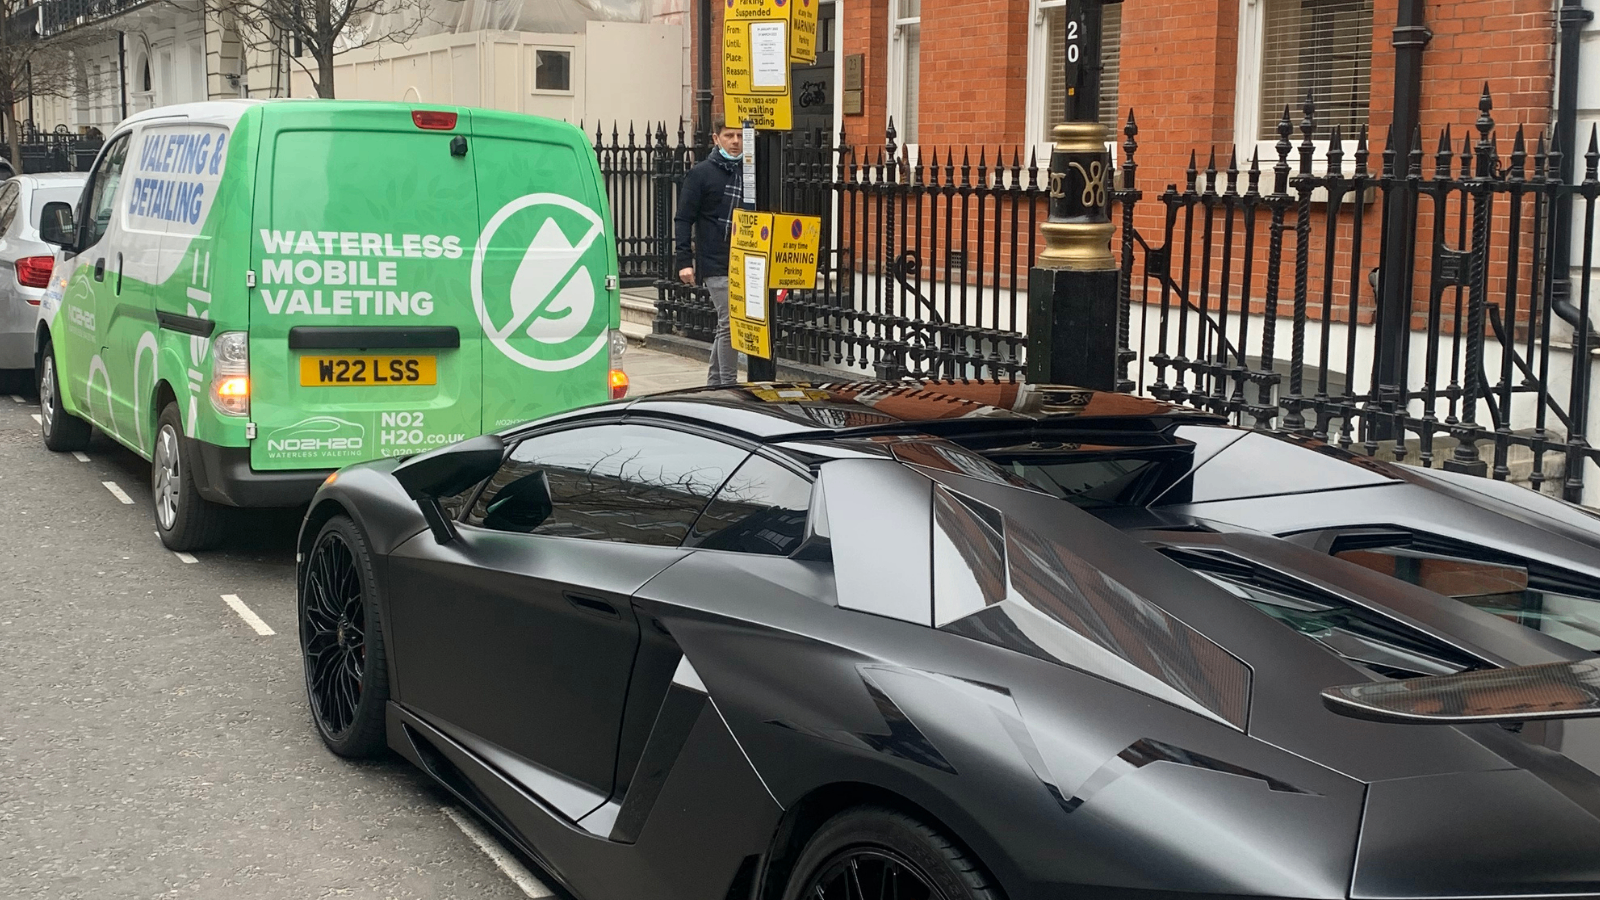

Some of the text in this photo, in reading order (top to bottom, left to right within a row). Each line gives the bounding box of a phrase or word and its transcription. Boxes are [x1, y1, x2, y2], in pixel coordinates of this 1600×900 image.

[736, 8, 771, 18] Suspended
[726, 26, 741, 34] From:
[726, 67, 749, 76] Reason:
[726, 80, 738, 89] Ref:
[738, 105, 774, 116] No waiting
[749, 116, 775, 127] ading
[139, 133, 226, 175] VALETING &
[129, 177, 204, 225] DETAILING
[738, 214, 758, 226] NOTICE
[259, 229, 463, 259] WATERLESS
[775, 252, 814, 264] WARNING
[261, 259, 398, 287] MOBILE
[784, 267, 802, 276] Parking
[779, 278, 805, 286] suspension
[259, 289, 434, 316] VALETING
[318, 359, 419, 383] W22 LSS
[381, 412, 424, 428] NO2
[267, 437, 363, 451] NO2H2O
[268, 451, 318, 459] WATERLESS
[392, 448, 413, 457] 020
